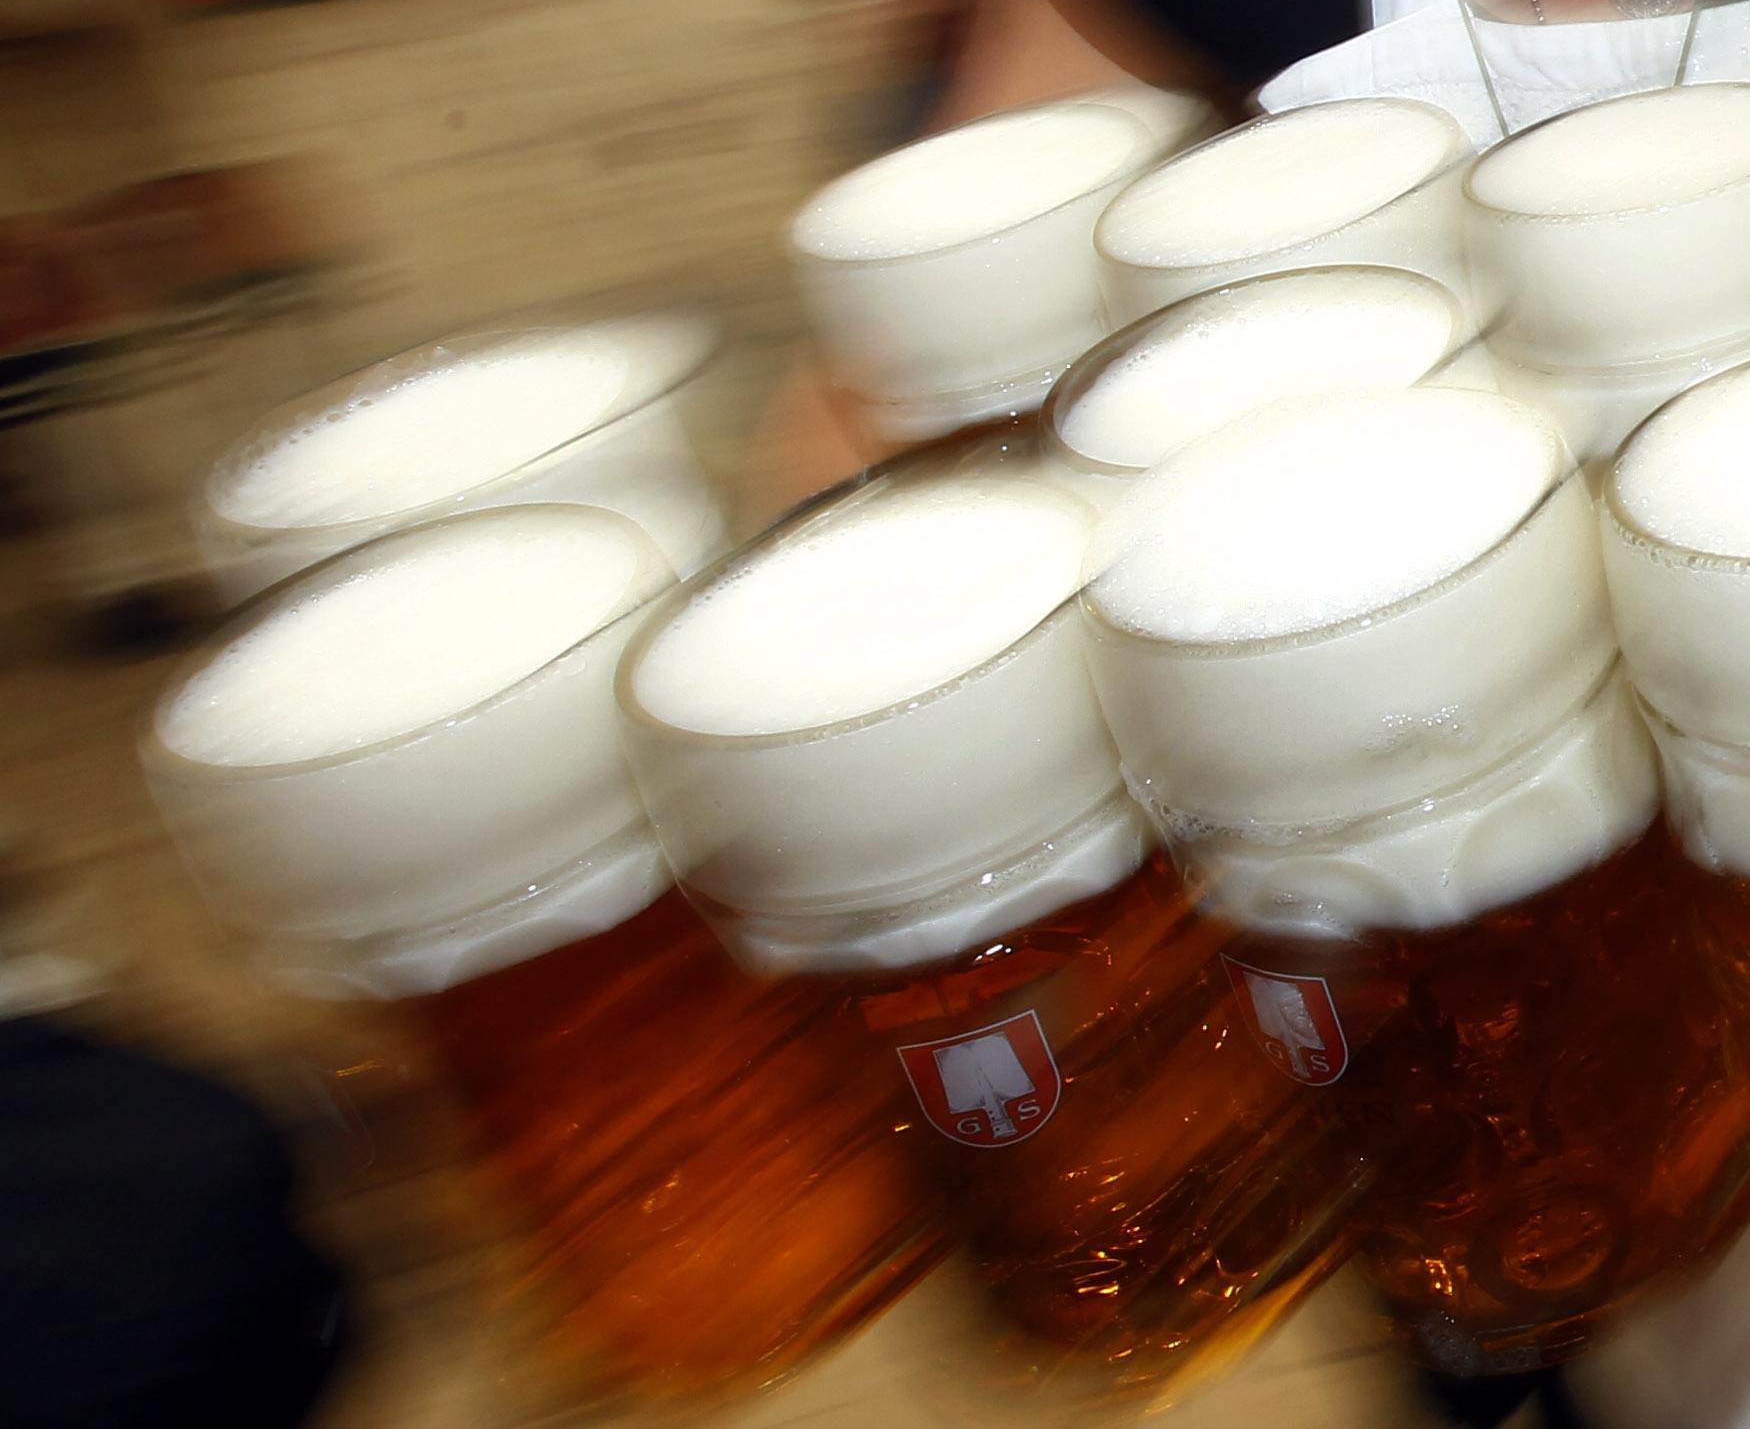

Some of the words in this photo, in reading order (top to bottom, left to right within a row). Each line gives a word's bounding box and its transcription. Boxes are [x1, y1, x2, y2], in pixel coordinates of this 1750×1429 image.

[1310, 1054, 1330, 1072] S
[956, 1116, 982, 1135] G
[1017, 1099, 1041, 1121] S
